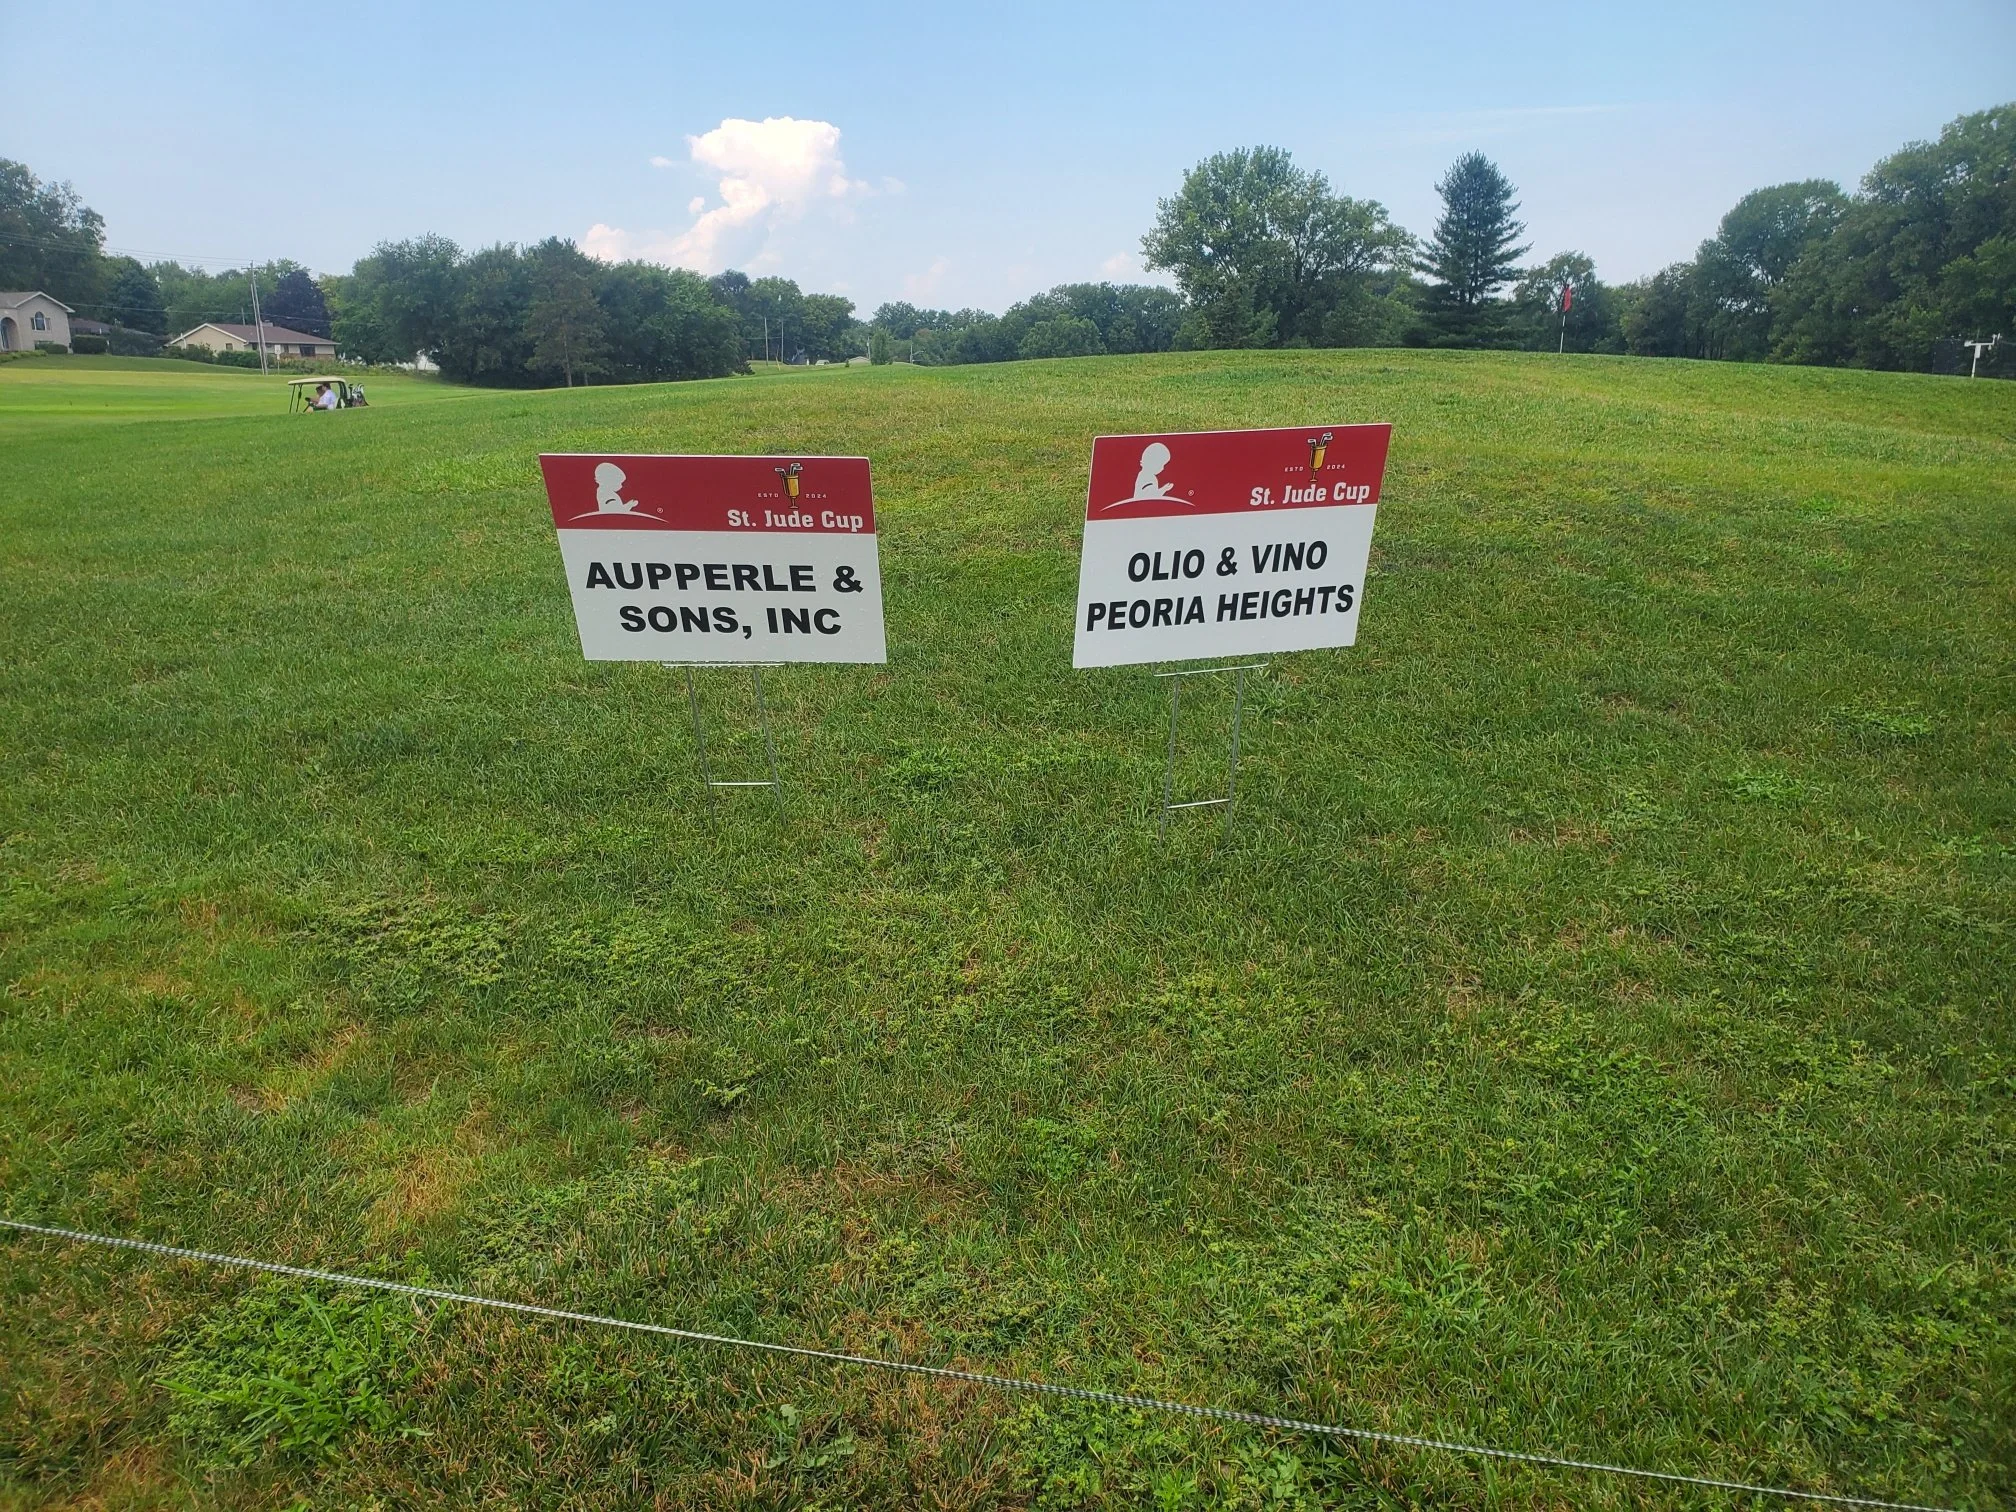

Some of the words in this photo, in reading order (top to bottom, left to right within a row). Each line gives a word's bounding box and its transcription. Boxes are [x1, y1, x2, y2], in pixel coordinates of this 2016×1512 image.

[1250, 487, 1275, 506] St.
[1282, 485, 1326, 504] Jude
[1334, 482, 1370, 503] Cup
[728, 509, 756, 527] St.
[765, 510, 814, 528] Jude
[821, 511, 863, 532] Cup
[1128, 549, 1205, 582] OLIO
[1216, 547, 1238, 577] &
[1251, 540, 1328, 574] VINO
[586, 562, 816, 592] AUPPERLE
[833, 565, 864, 593] &
[620, 606, 752, 639] SONS,
[766, 608, 842, 634] INC
[1087, 596, 1205, 631] PEORIA
[1216, 584, 1354, 622] HEIGHTS
